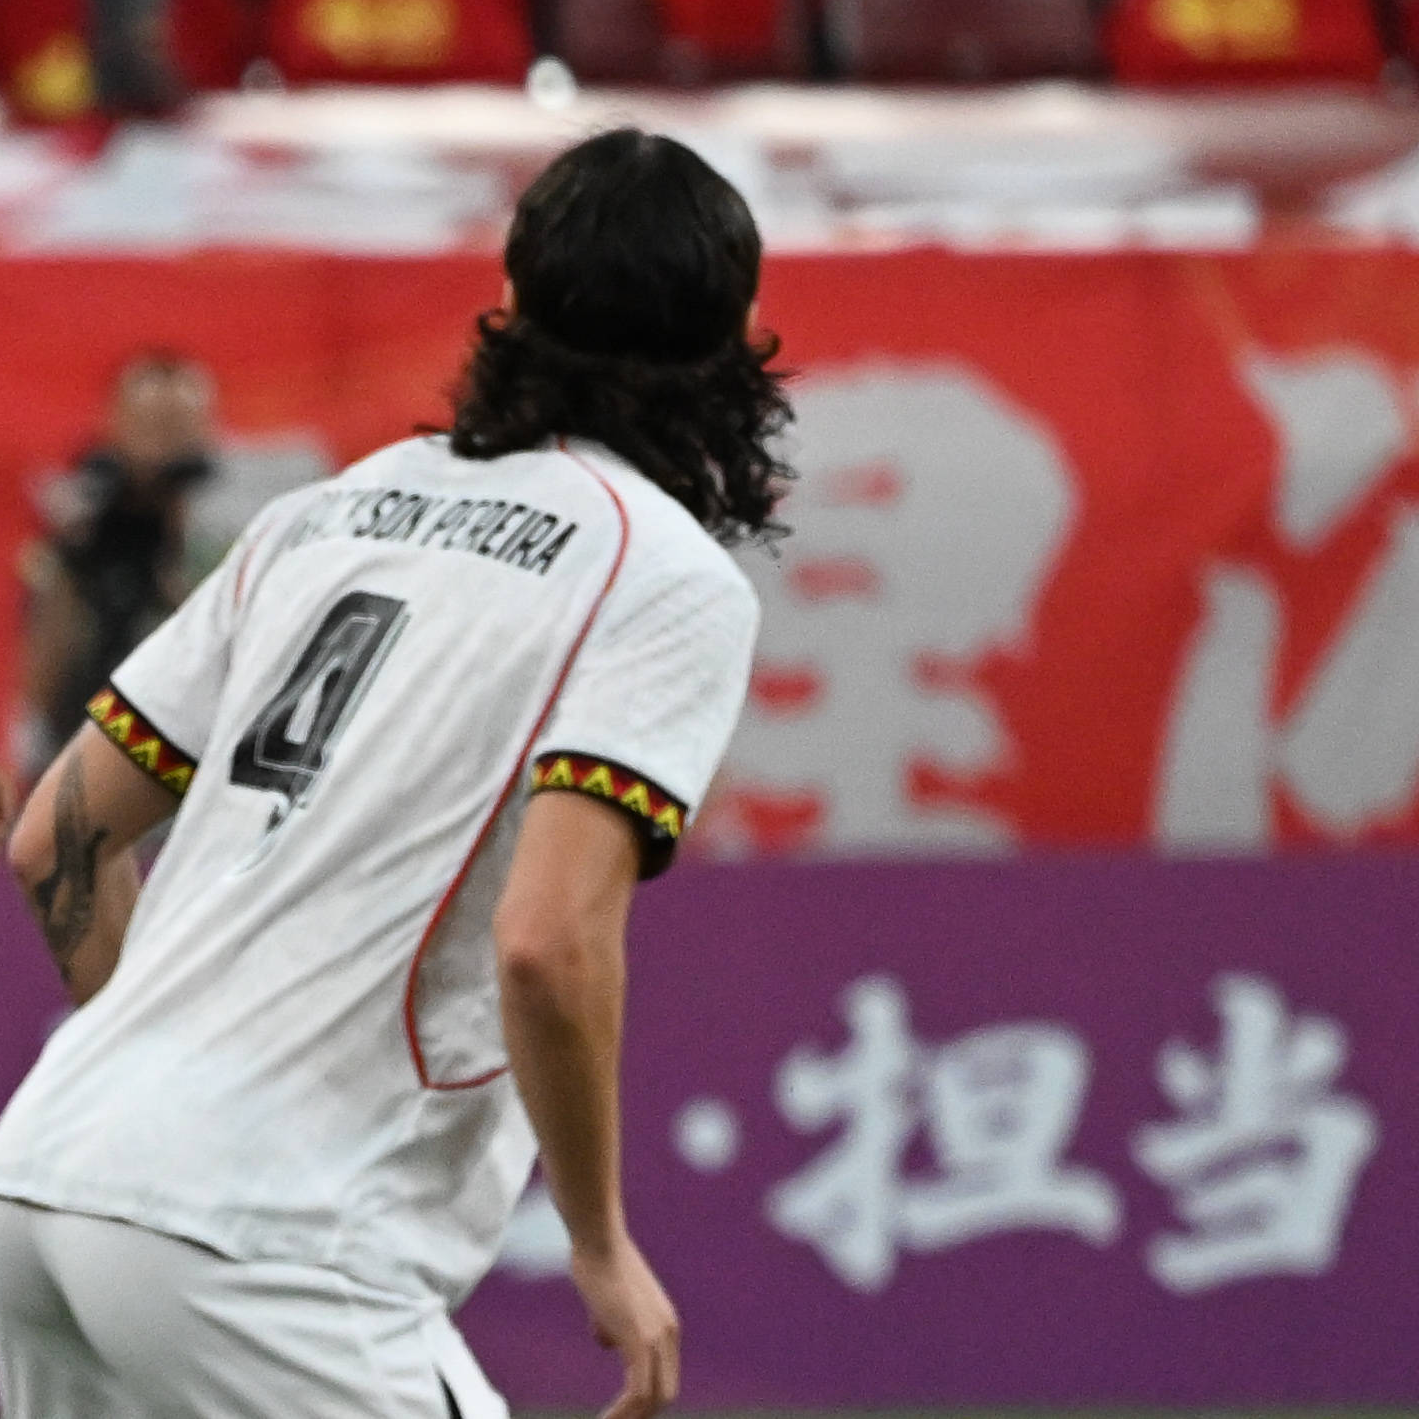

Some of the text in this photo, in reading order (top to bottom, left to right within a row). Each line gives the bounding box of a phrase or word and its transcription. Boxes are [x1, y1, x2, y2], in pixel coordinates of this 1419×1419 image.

[419, 497, 579, 577] PEREIRA
[227, 588, 411, 836] 4
[771, 974, 1376, 1296] 担当
